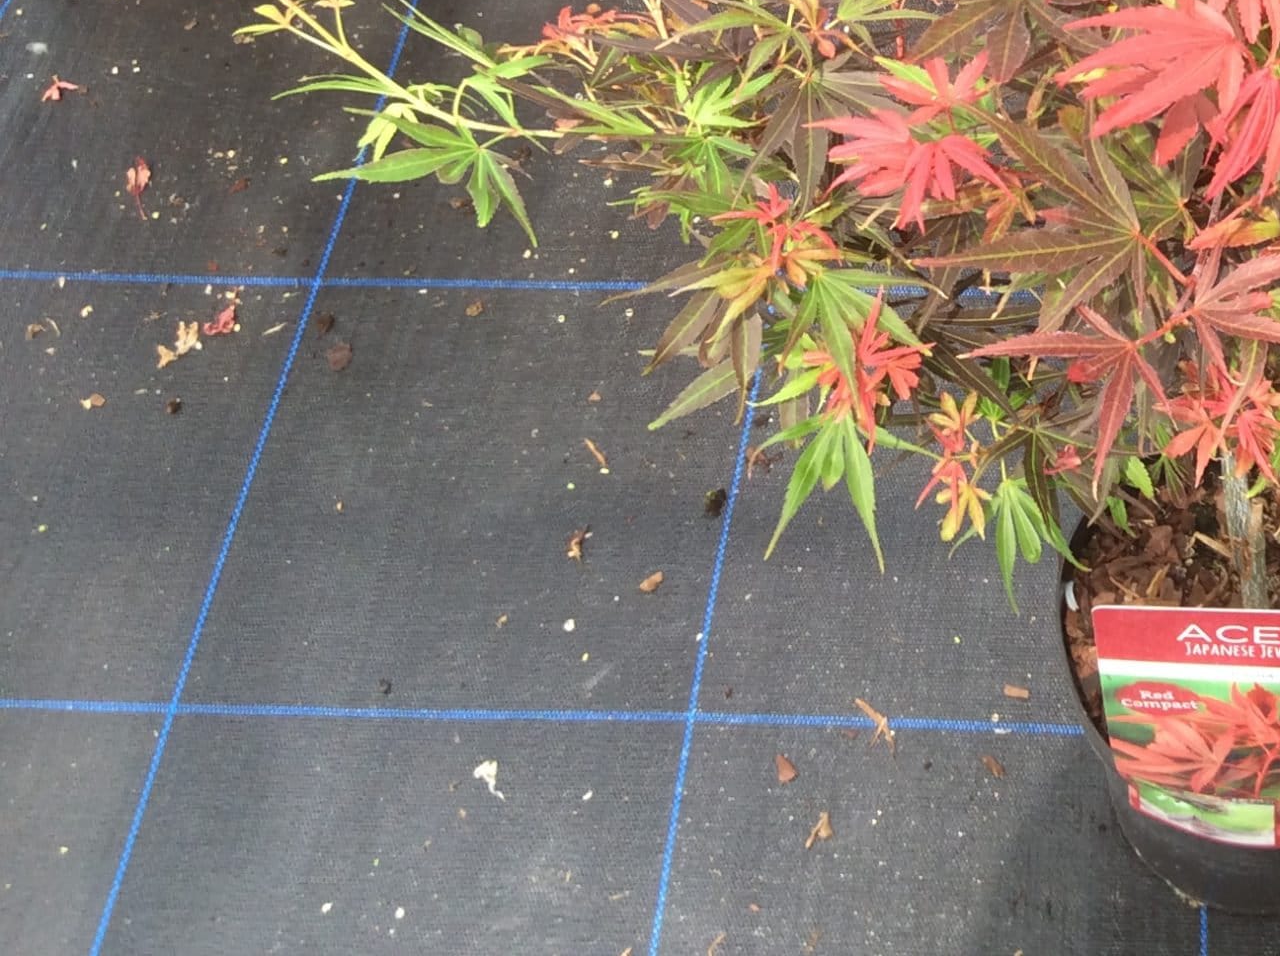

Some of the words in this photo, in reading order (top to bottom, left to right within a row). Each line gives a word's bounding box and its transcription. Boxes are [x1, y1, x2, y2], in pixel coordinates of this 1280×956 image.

[1184, 641, 1256, 658] JAPANESE
[1139, 689, 1175, 701] Red
[1120, 697, 1199, 712] Compact
